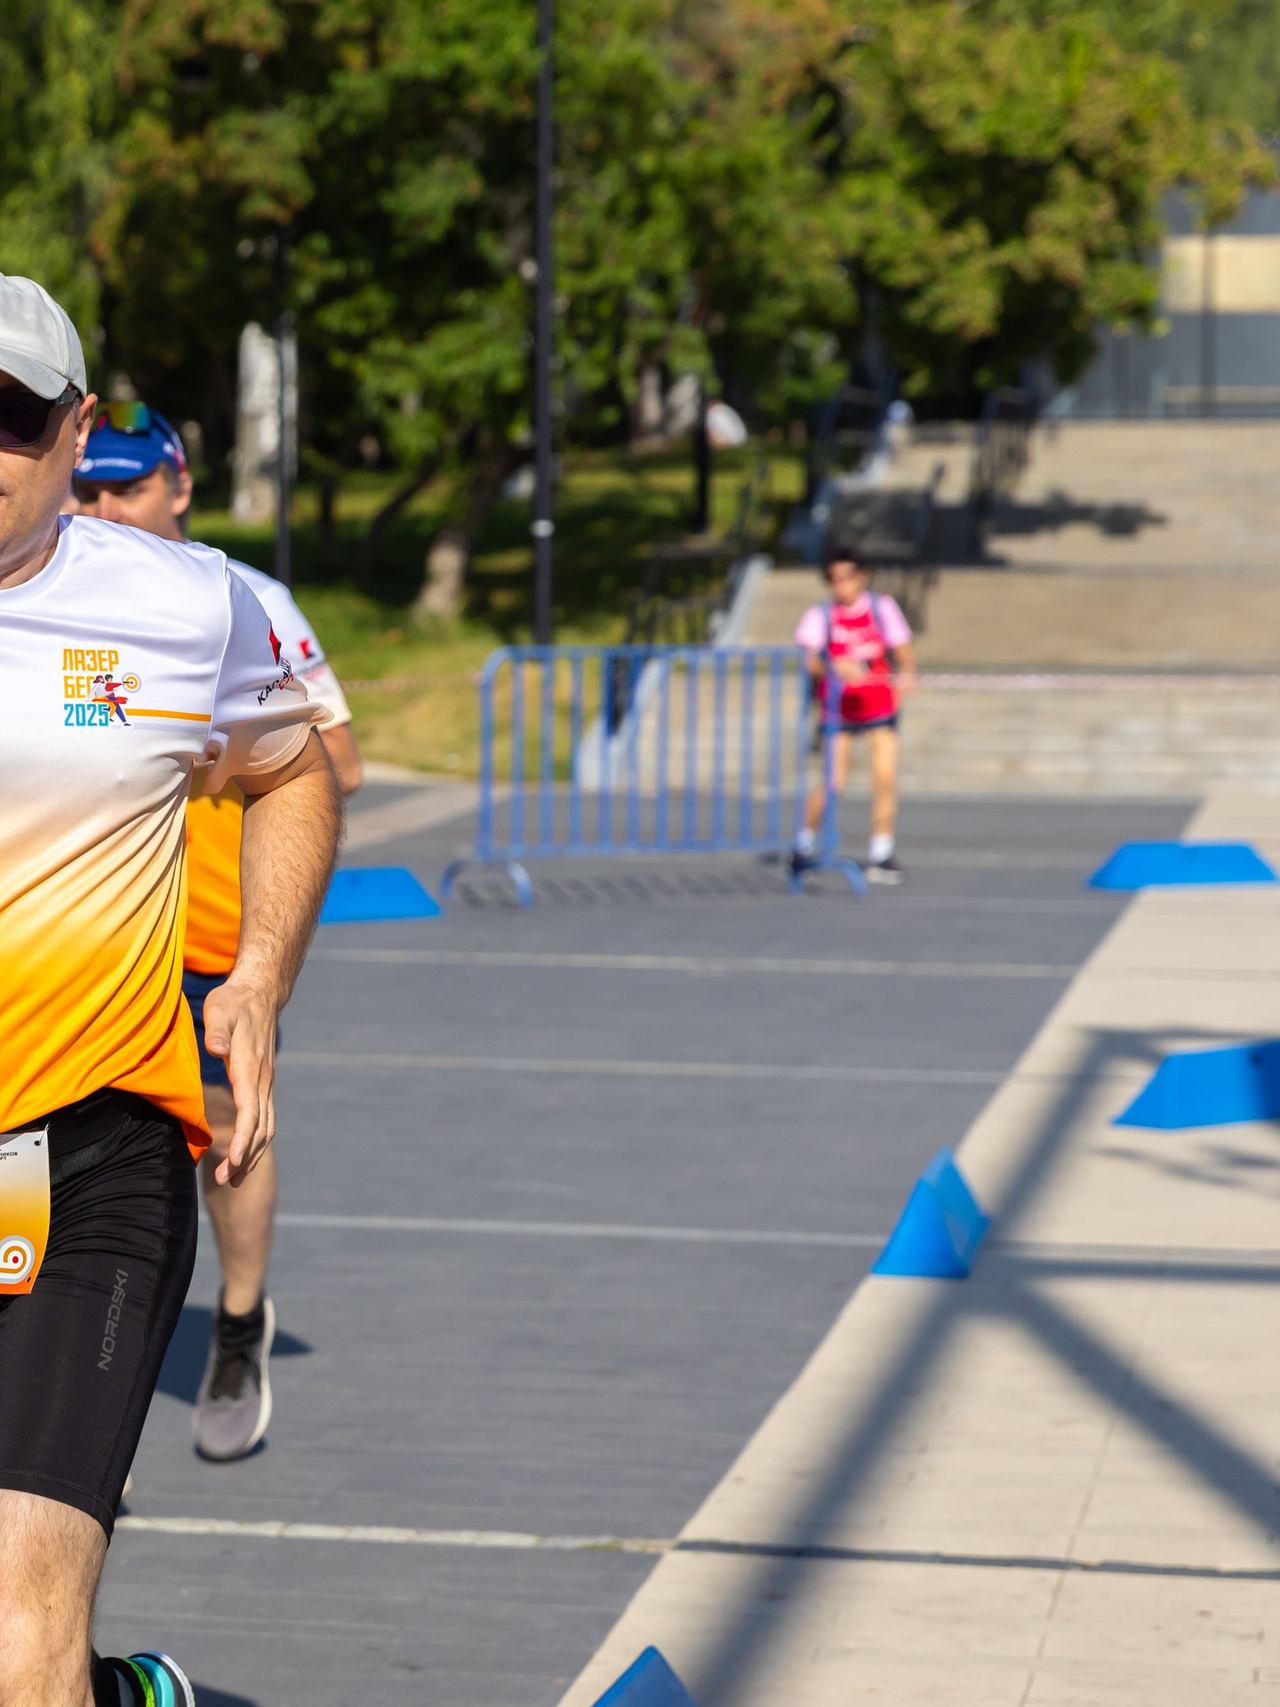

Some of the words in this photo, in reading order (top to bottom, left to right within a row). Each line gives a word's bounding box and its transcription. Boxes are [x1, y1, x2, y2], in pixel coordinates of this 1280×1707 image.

[62, 649, 119, 672] ЛАЗЕР
[64, 675, 95, 698] БЕГ
[64, 704, 109, 726] 2025
[97, 1268, 128, 1371] NORDSKI
